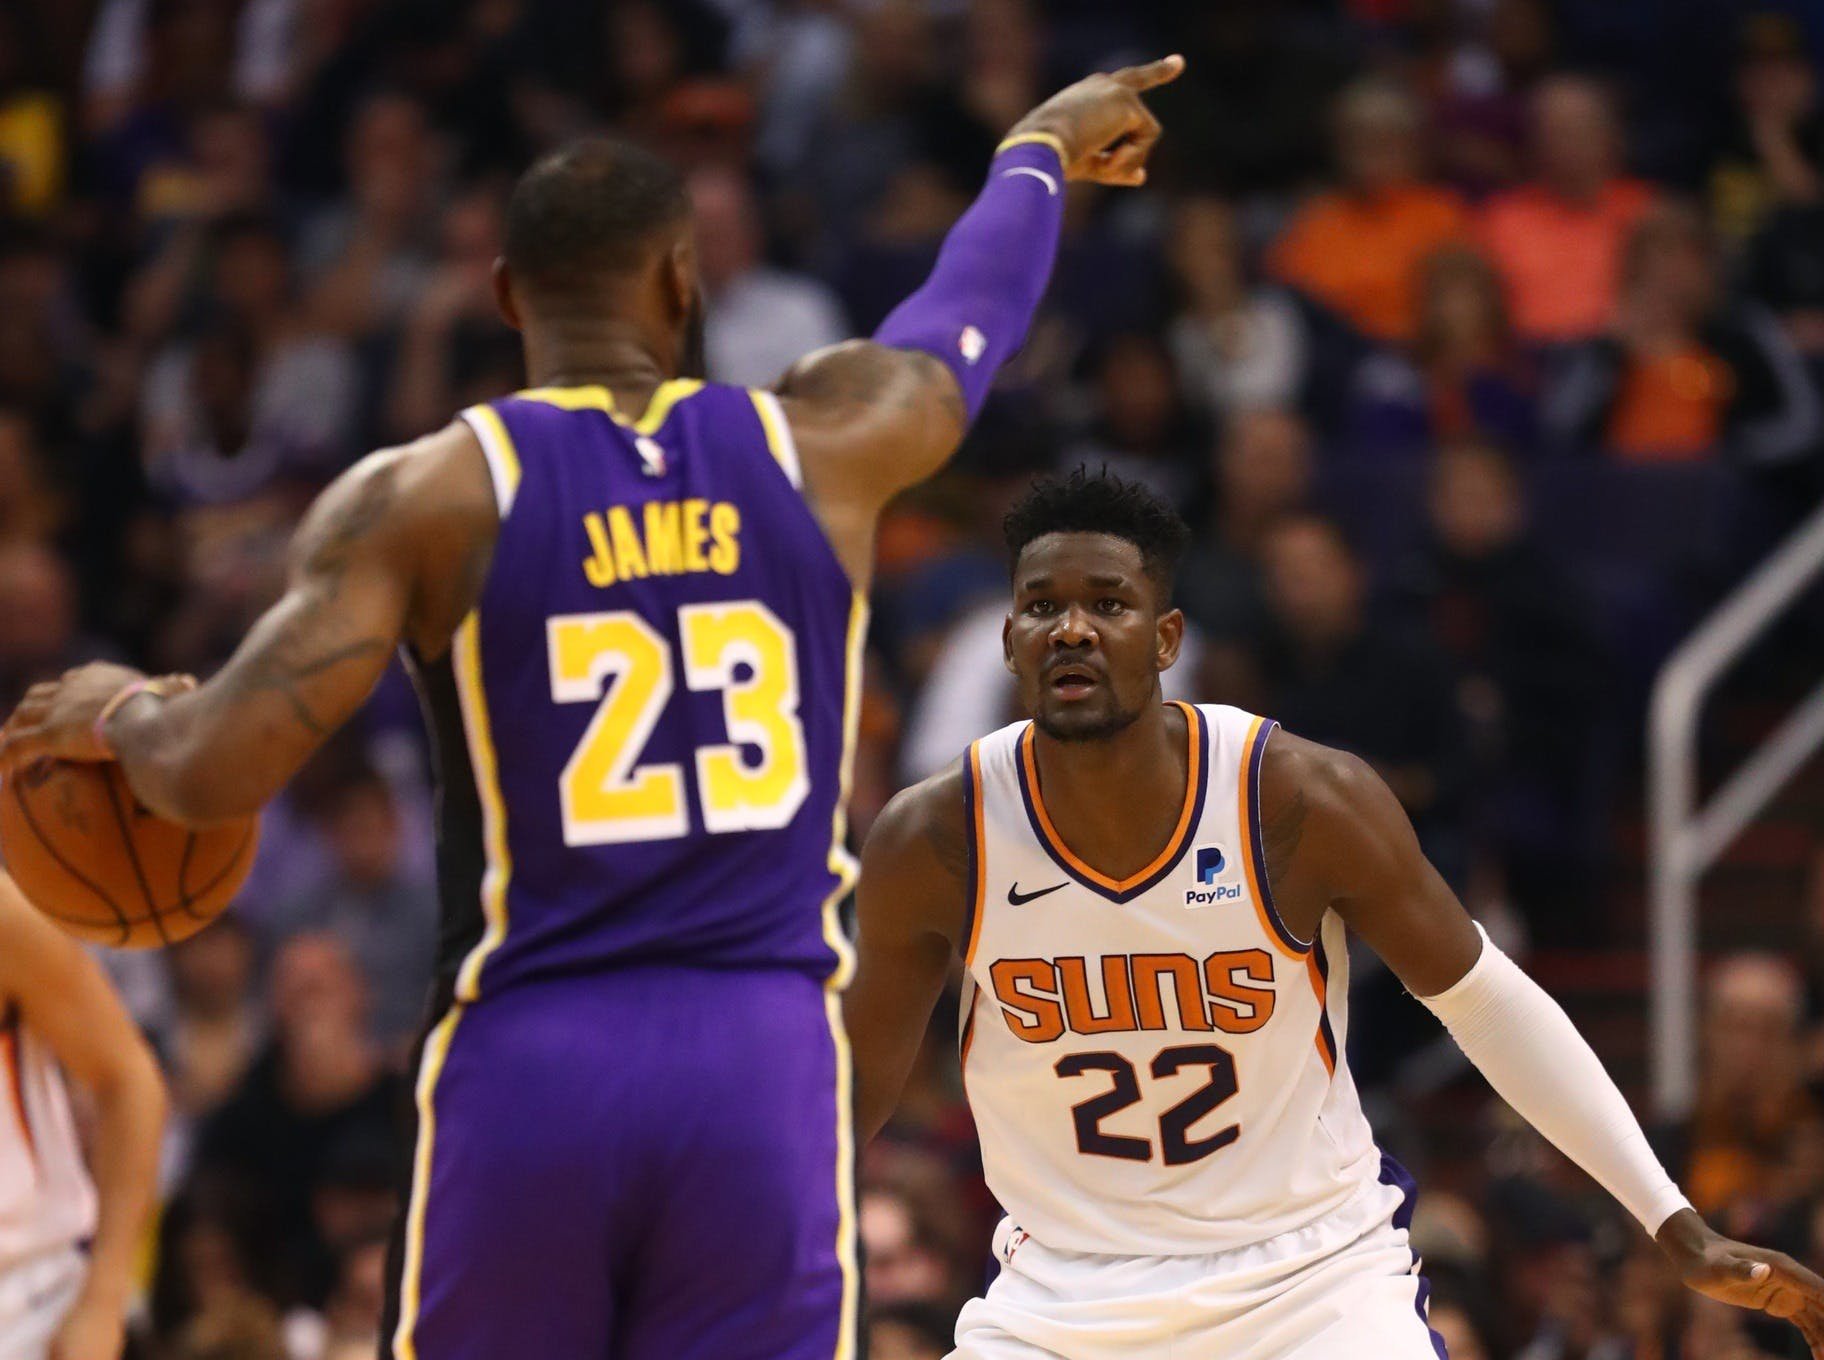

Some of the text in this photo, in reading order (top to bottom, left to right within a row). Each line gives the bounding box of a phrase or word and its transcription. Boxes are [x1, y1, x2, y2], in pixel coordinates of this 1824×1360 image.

[582, 498, 740, 588] JAMES
[546, 600, 811, 847] 23
[1186, 884, 1240, 905] PayPal
[1053, 1043, 1241, 1166] 22
